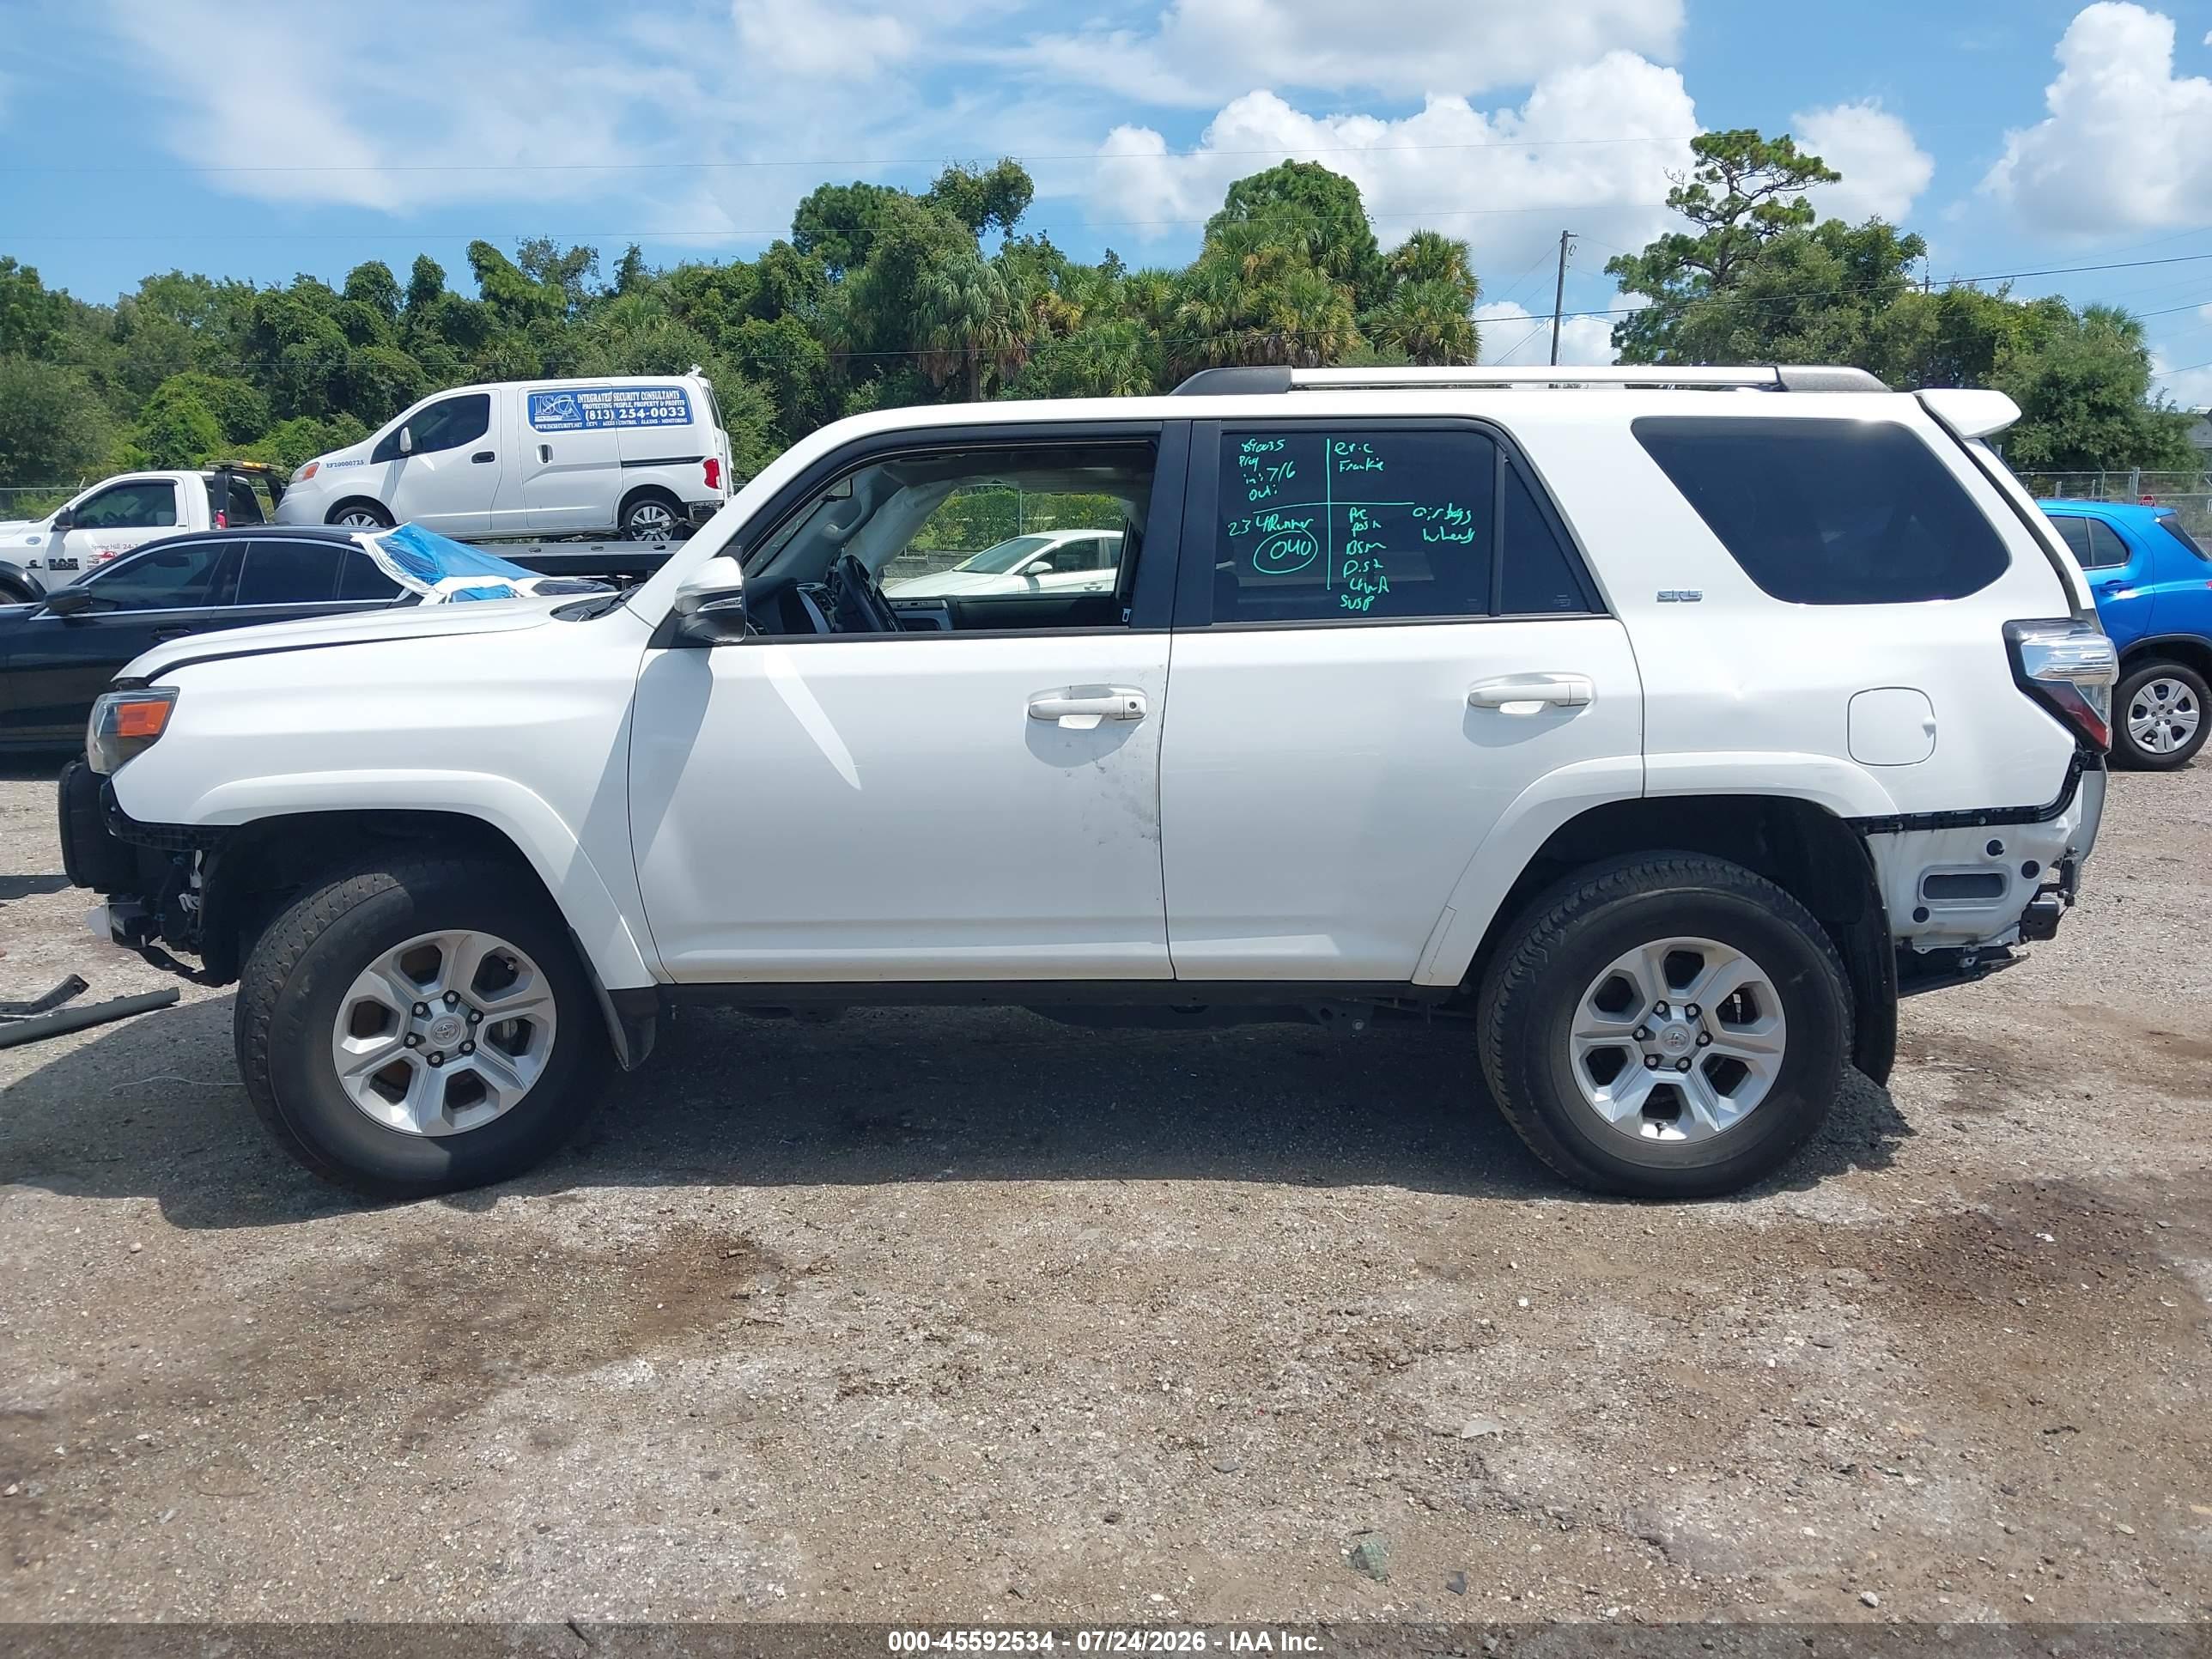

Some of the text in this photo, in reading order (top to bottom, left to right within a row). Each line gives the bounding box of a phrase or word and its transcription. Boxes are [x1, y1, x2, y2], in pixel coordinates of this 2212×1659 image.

[576, 390, 680, 404] INTEGRATED SECURITY CONSULTANTS
[582, 402, 613, 410] PROTECTING
[585, 406, 686, 422] (813) 254-0033
[1266, 460, 1297, 483] 7/6
[1227, 519, 1252, 537] 23
